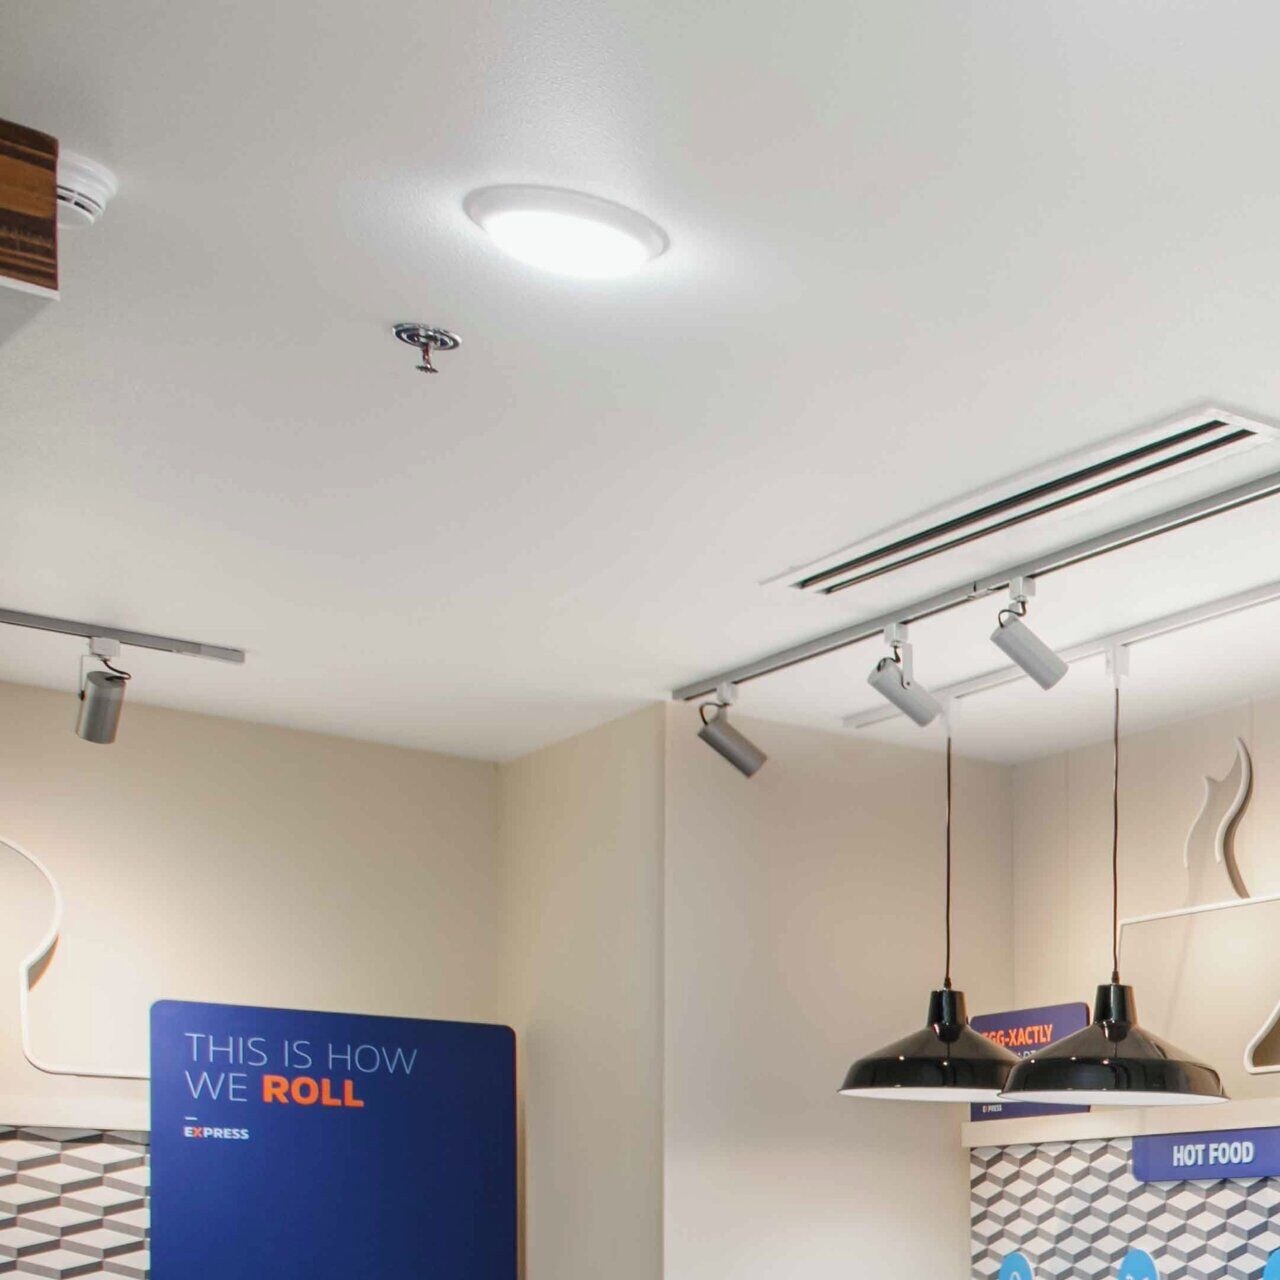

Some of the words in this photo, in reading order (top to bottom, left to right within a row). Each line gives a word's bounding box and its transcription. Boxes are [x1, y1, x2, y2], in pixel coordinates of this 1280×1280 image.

[184, 1032, 269, 1067] THIS
[284, 1040, 313, 1070] IS
[327, 1043, 418, 1075] HOW
[185, 1070, 248, 1103] WE
[262, 1073, 365, 1108] ROLL
[183, 1126, 250, 1140] EXPRESS
[1172, 1143, 1206, 1167] HOT
[1208, 1141, 1255, 1165] FOOD
